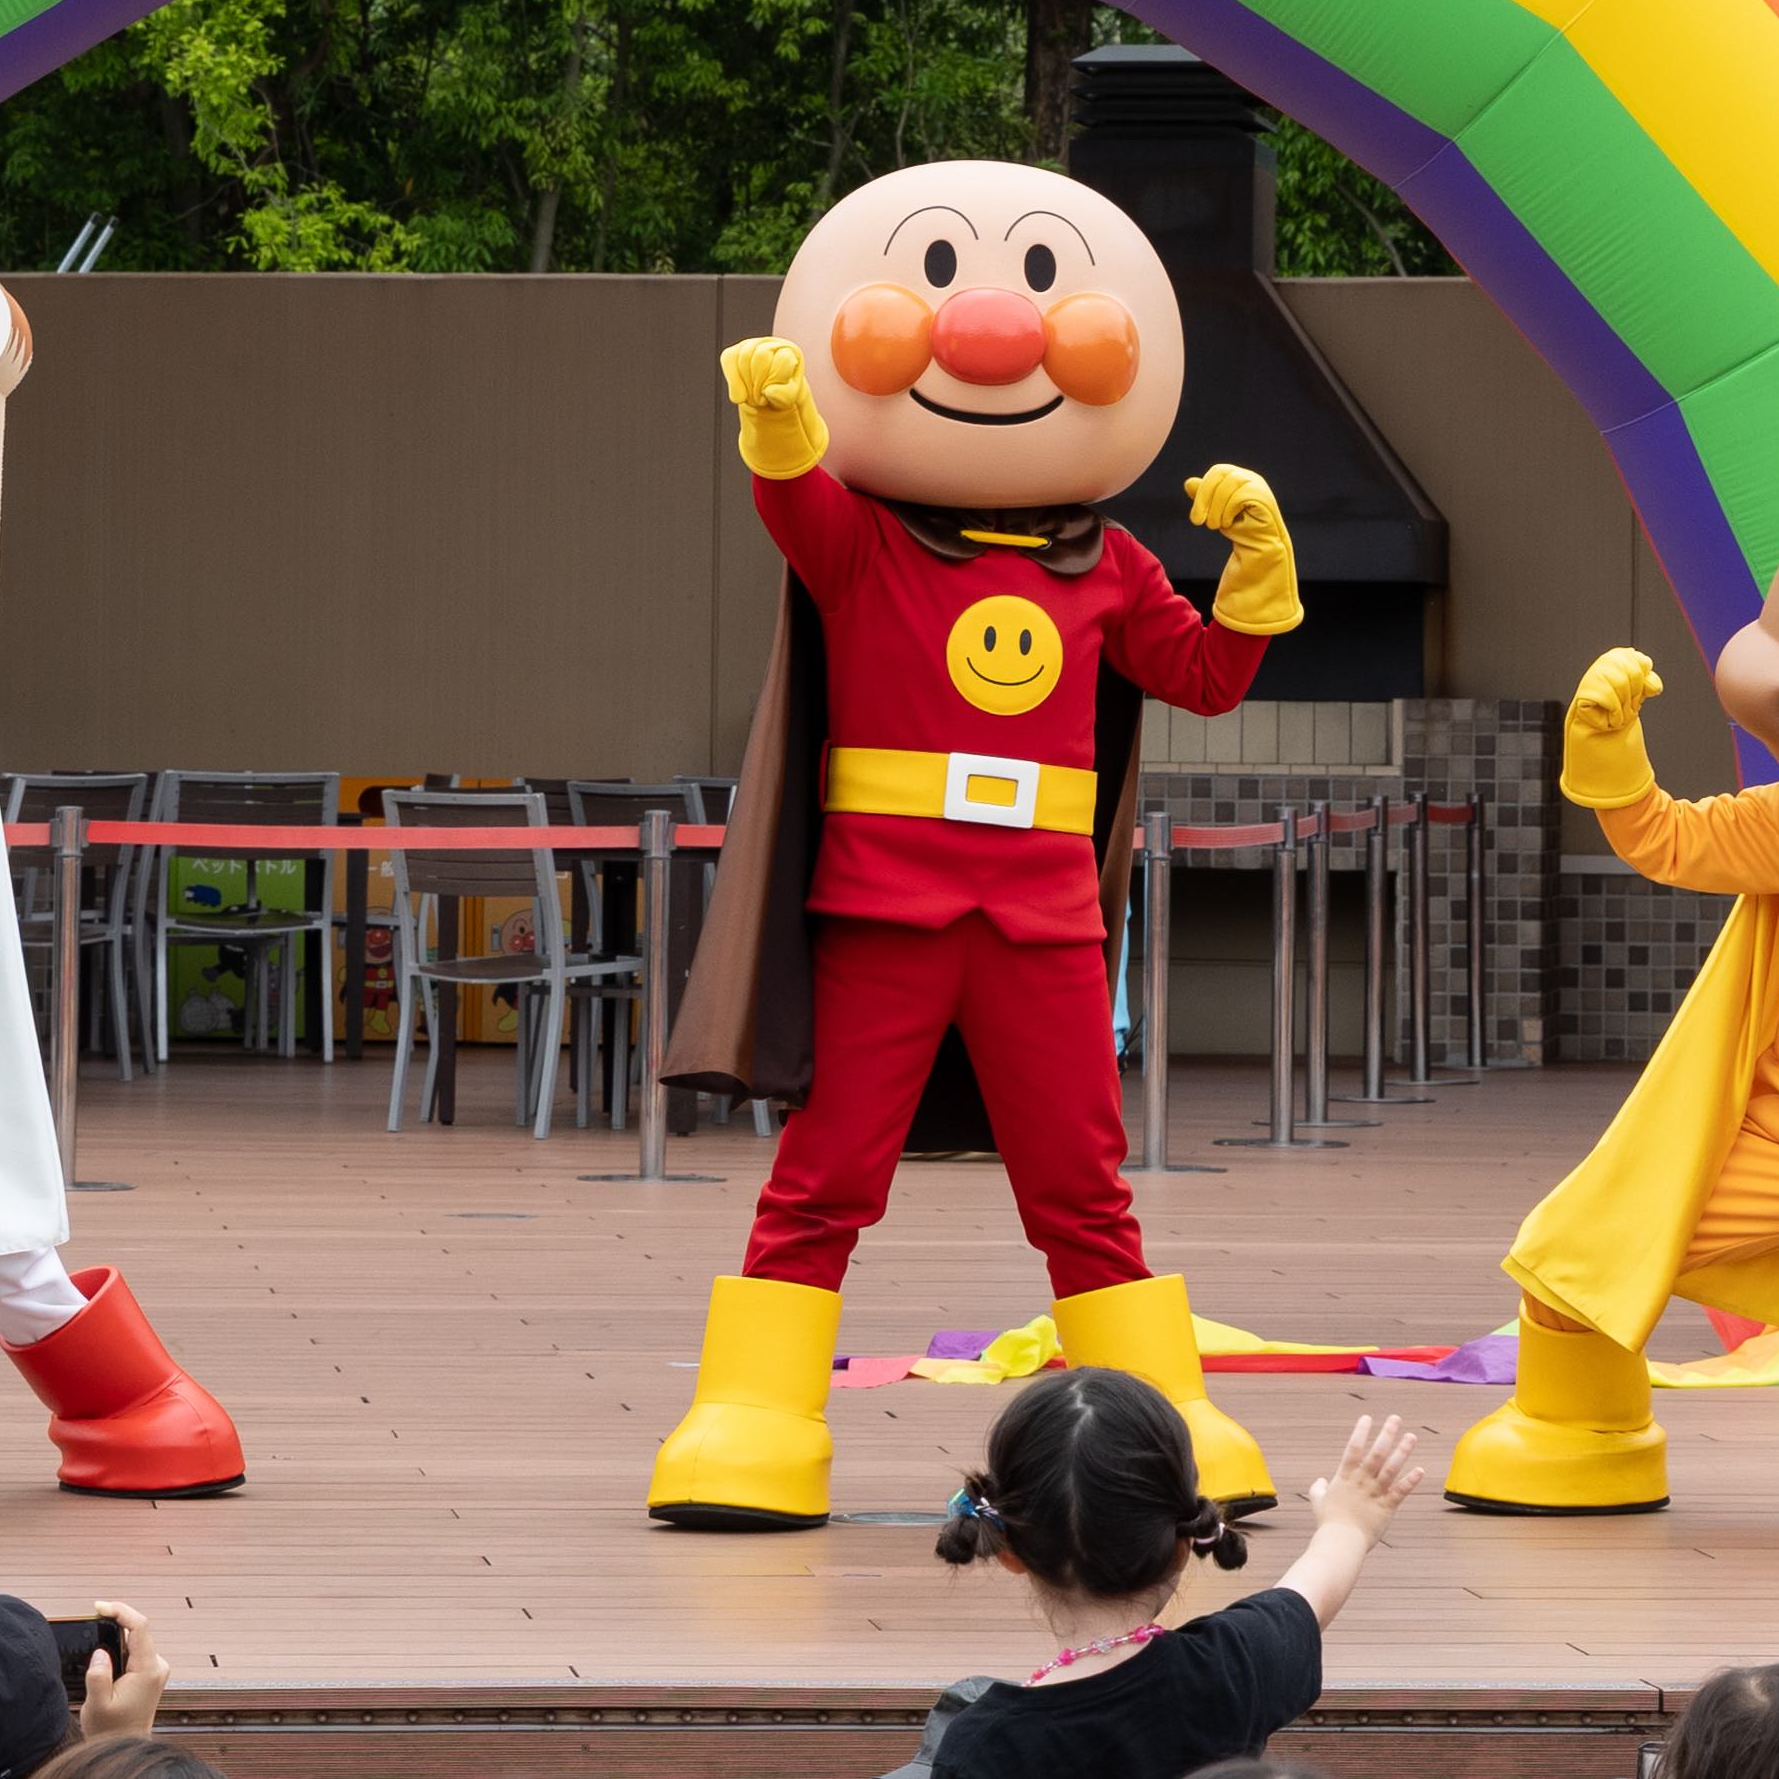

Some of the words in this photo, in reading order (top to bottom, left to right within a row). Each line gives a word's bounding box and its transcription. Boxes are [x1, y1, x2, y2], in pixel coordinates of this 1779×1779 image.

[191, 858, 298, 876] ペットトル
